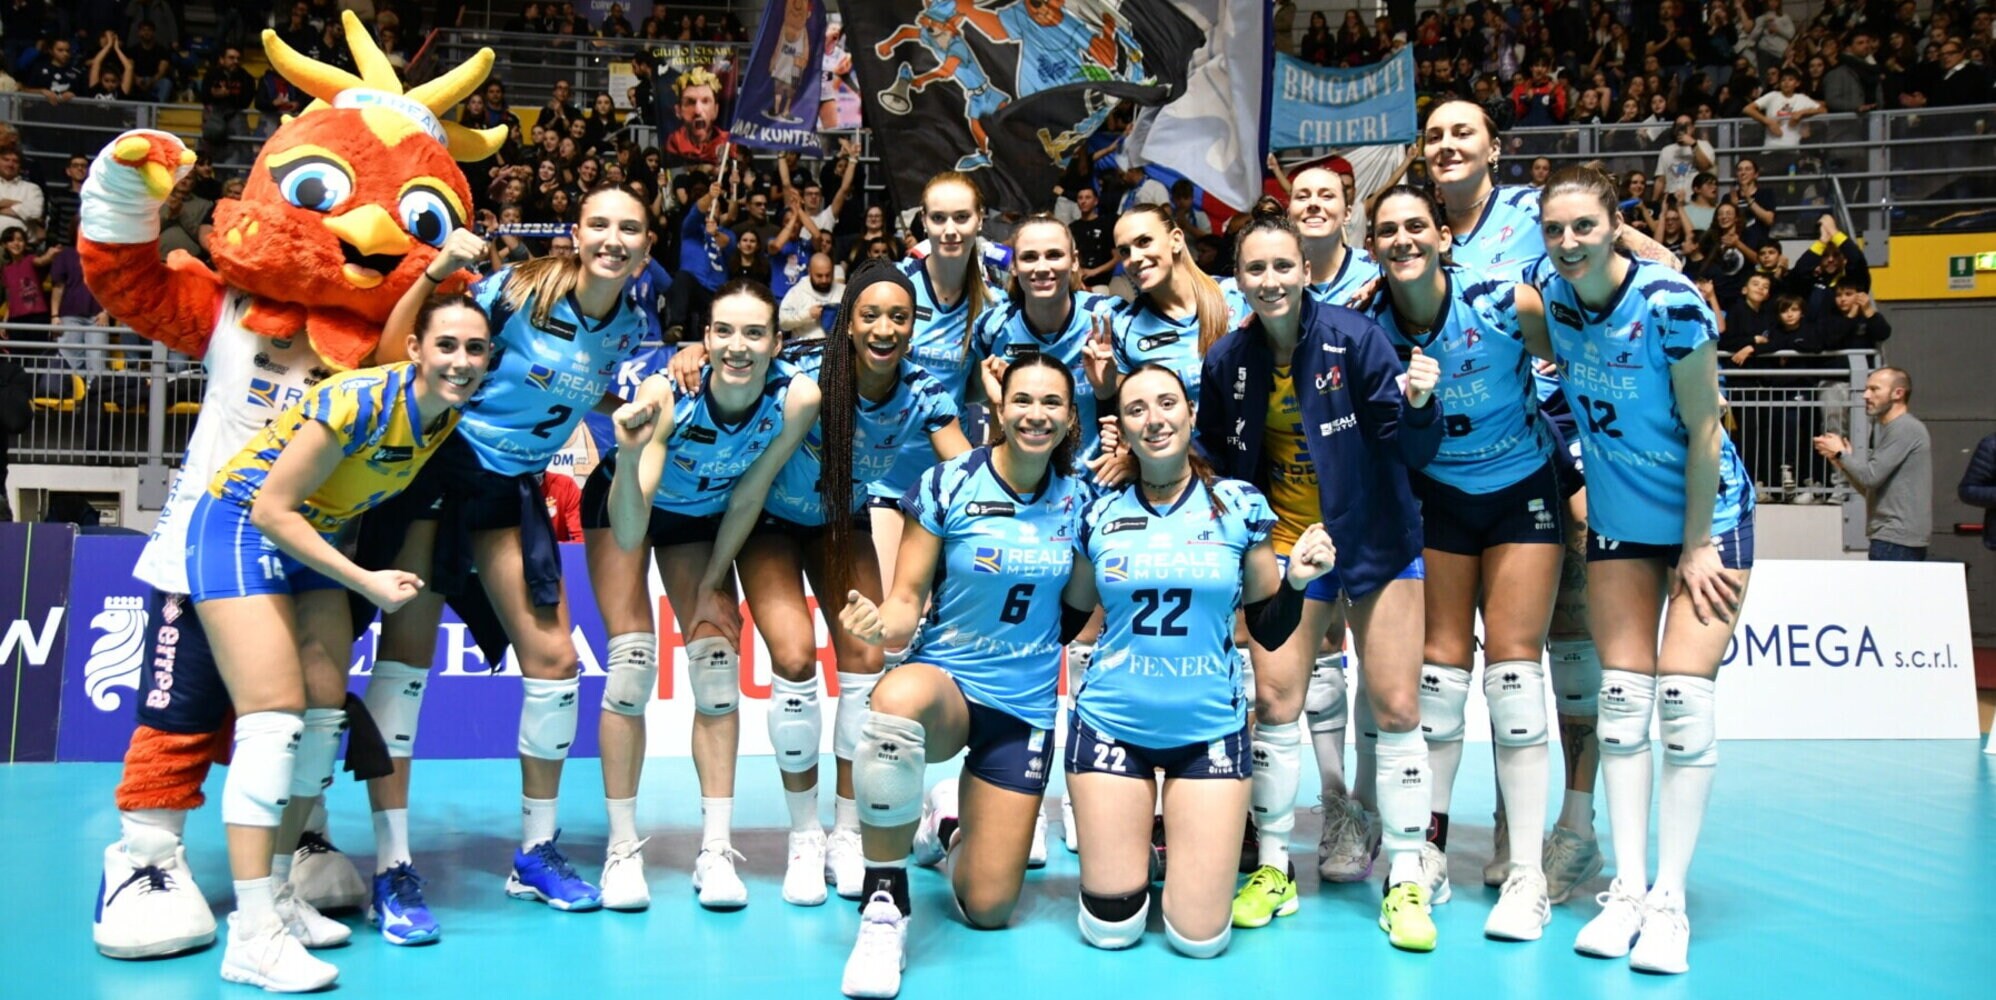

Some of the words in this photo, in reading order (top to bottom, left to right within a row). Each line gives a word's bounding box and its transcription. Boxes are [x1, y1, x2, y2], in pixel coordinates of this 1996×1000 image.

[1283, 58, 1405, 104] BRIGANTI
[1299, 112, 1388, 145] CHIERI
[1573, 362, 1638, 390] REALE
[1573, 376, 1640, 400] MUTUA
[530, 404, 573, 439] 2
[1134, 551, 1221, 568] REALE
[1134, 567, 1221, 580] MUTUA
[1000, 583, 1036, 615] 6
[1131, 588, 1193, 637] 22
[1895, 643, 1959, 669] s.c.r.l.
[1094, 743, 1126, 772] 22
